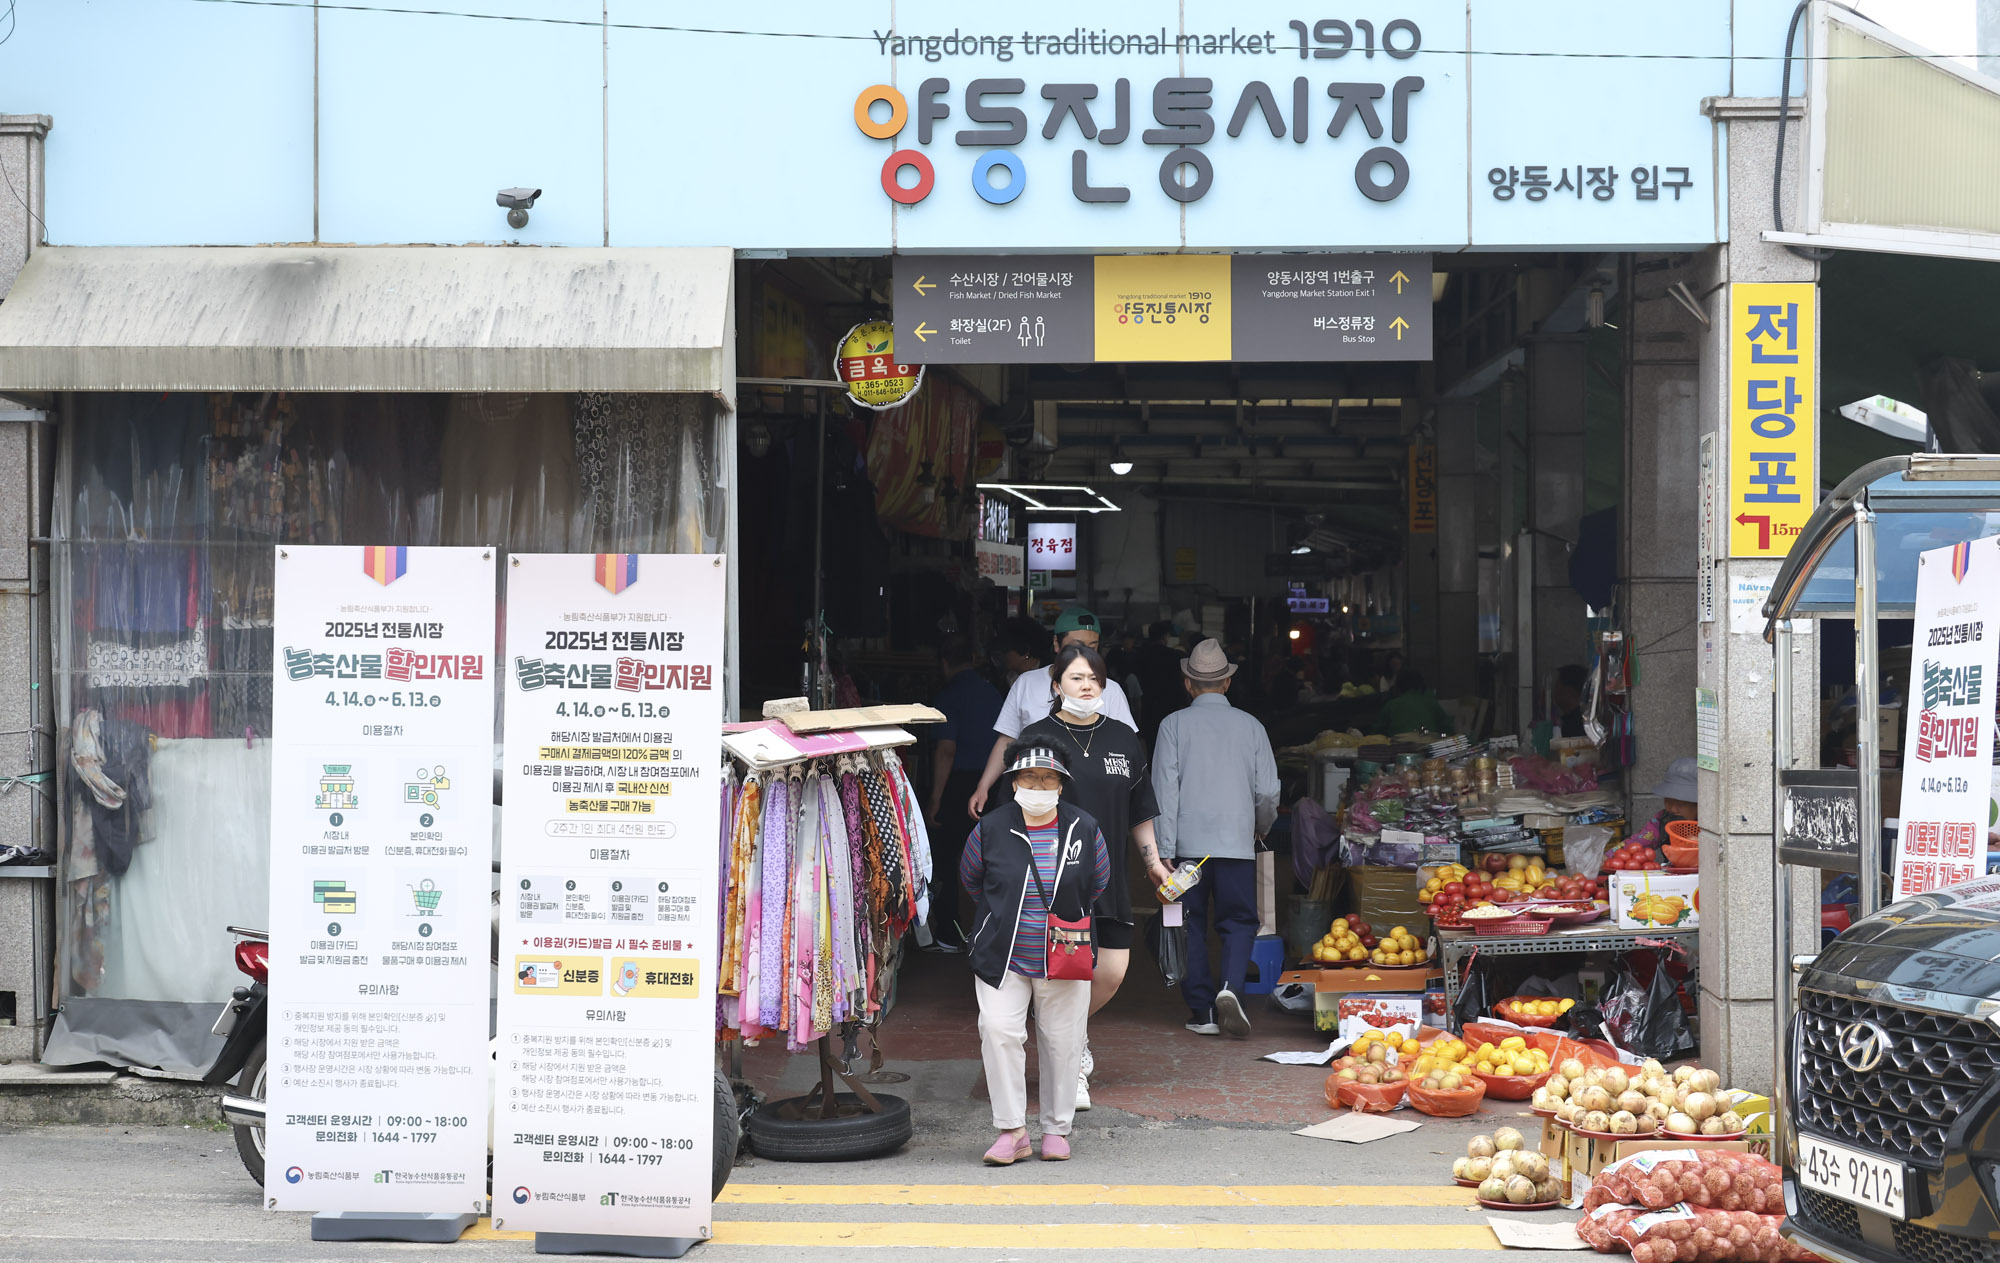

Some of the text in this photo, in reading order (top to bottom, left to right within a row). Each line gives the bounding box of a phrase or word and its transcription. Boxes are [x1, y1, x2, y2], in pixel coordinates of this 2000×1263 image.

[873, 19, 1422, 63] Yangdong traditional market 1910
[1488, 165, 1693, 201] 양동시장 입구
[950, 272, 1073, 287] 수산시장 건어물시장
[1268, 270, 1375, 285] 양동시장역 1번출구
[998, 291, 1018, 299] Dried
[1020, 291, 1035, 299] Fish
[1262, 290, 1298, 298] Yangdong
[1328, 289, 1354, 297] Station
[950, 318, 1011, 332] 화장실(2F)
[1314, 316, 1375, 330] 버스정류장
[1358, 335, 1375, 343] Stop
[856, 379, 904, 389] T.365-0523
[1743, 302, 1802, 504] 전당포
[1031, 538, 1073, 553] 정육점
[628, 613, 668, 622] 지원합니다
[325, 622, 443, 639] 2025년 전통시장
[1928, 621, 1983, 646] 2025년 전통시장
[545, 631, 684, 651] 2025년 전통시장
[283, 646, 483, 682] 농축산물 할인지원
[515, 656, 712, 692] 농축산물 할인지원
[1923, 659, 1982, 711] 농축산물
[363, 725, 403, 736] 이용절차
[1916, 709, 1979, 763] 할인지원
[551, 732, 672, 744] 해당시장 발급처에서 이용권
[541, 748, 682, 761] 구매시 결제금액의 120% 금액 의
[1103, 758, 1129, 767] MUSIC
[523, 765, 699, 778] 이용권을 발급하며, 시장 내 참여점포에서
[552, 782, 669, 795] 이용권 제시 후 국내산 신선
[569, 800, 651, 813] 농축산물 구매 가능
[323, 831, 349, 840] 시장 내
[553, 823, 578, 834] 2주간
[597, 824, 615, 835] 최대
[619, 824, 644, 835] 4천원
[647, 824, 666, 836] 한도
[410, 832, 442, 841] 본인확인
[1905, 821, 1976, 859] 이용권 (카드)
[302, 846, 327, 855] 이용권
[354, 846, 369, 855] 방문
[415, 847, 447, 856] 휴대전화
[590, 849, 630, 860] 이용절차
[311, 941, 334, 950] 이용권
[392, 942, 424, 951] 해당시장
[533, 937, 682, 951] 이용권(카드)발급 시 필수 준비물
[300, 956, 316, 965] 발급
[327, 956, 351, 965] 지원금
[426, 957, 449, 966] 이용권
[450, 957, 467, 966] 제시
[563, 970, 599, 983] 신분증
[645, 972, 693, 986] 휴대전화
[358, 984, 399, 996] 유의사항
[586, 1010, 626, 1022] 유의사항
[285, 1115, 467, 1127] 고객센터 운영시간 09:00 18:00
[316, 1131, 437, 1143] 문의전화 1644 1797
[513, 1134, 693, 1150] 고객센터 운영시간 09:00 18:00
[543, 1151, 662, 1165] 문의전화 1644 1797
[308, 1172, 359, 1180] 농림축산식품부
[395, 1172, 465, 1181] 한국농수산식품유통공사
[1808, 1146, 1894, 1207] 43수 9212
[535, 1192, 585, 1202] 농림축산식품부
[621, 1194, 691, 1204] 한국농수산식품유통공사
